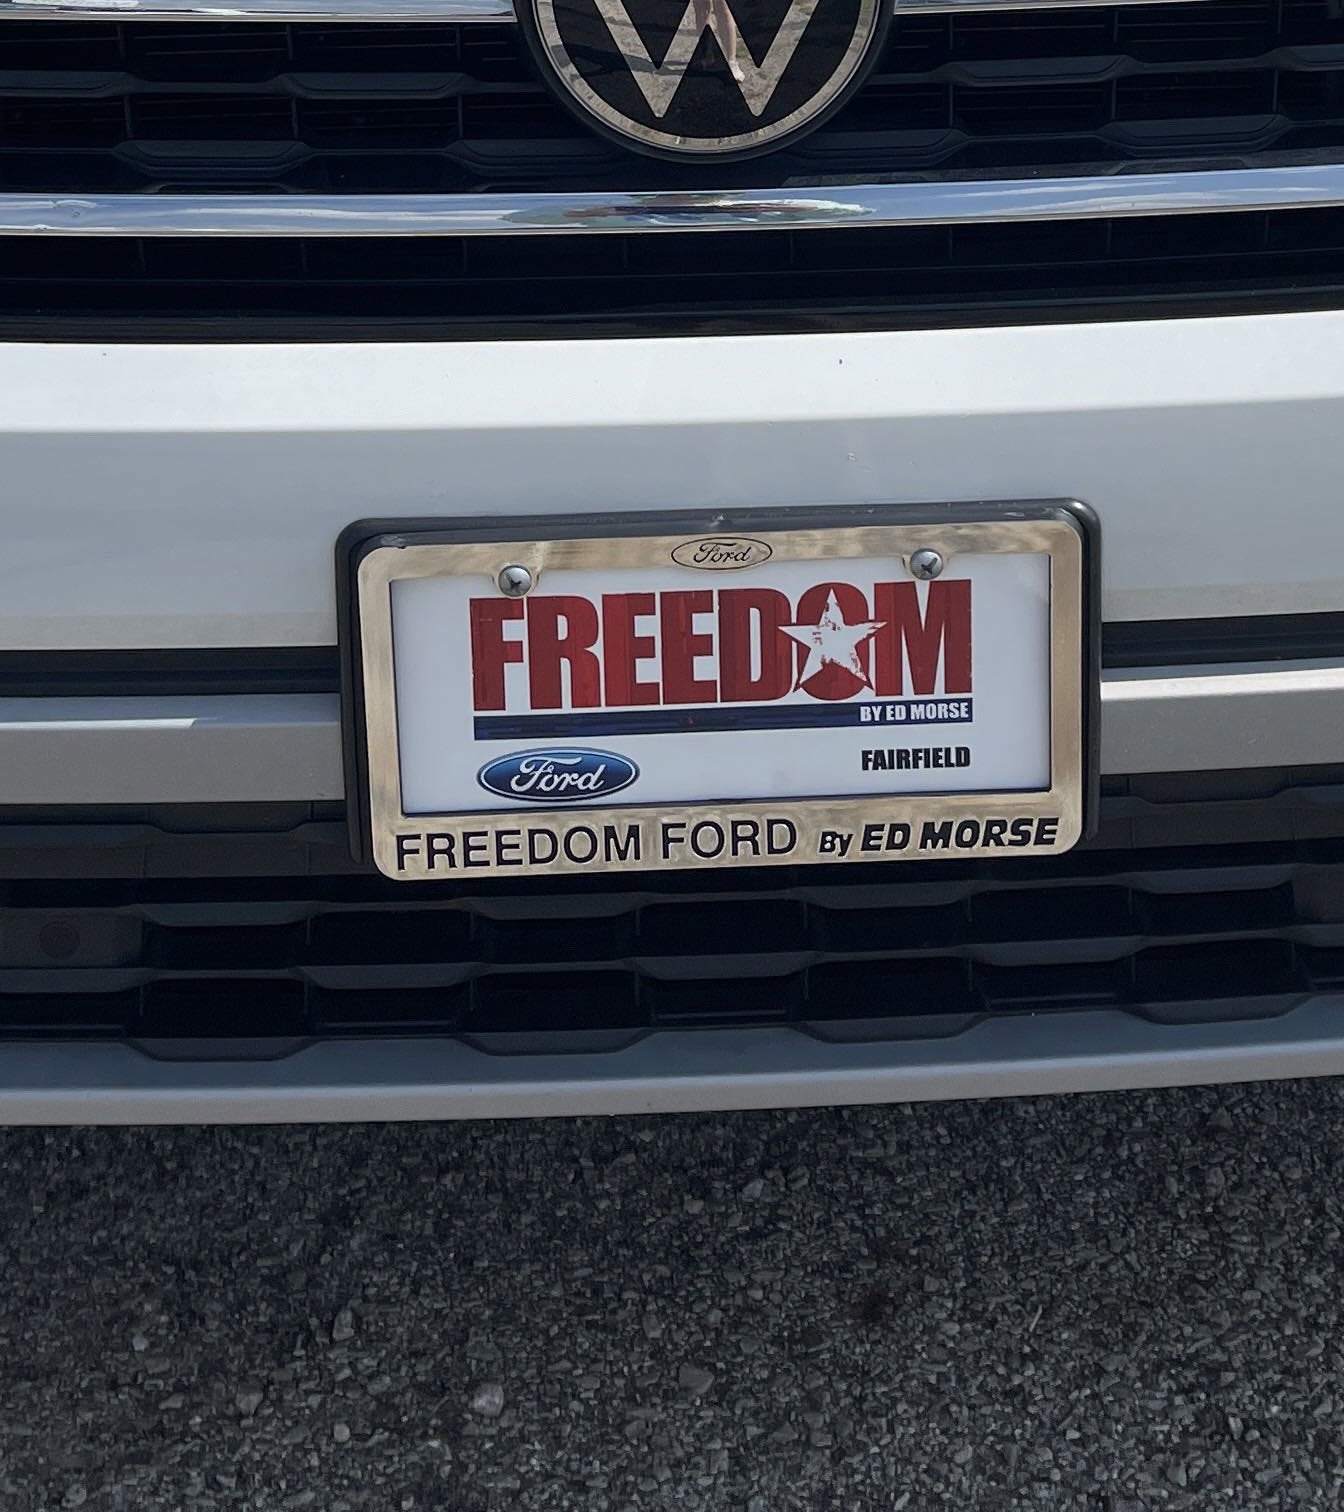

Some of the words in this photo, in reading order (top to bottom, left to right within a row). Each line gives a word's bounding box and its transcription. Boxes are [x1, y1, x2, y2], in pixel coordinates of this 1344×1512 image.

[693, 542, 752, 563] Ford
[470, 579, 972, 711] FREEDOM
[860, 705, 883, 722] BY
[885, 704, 906, 721] ED
[910, 701, 969, 720] MORSE
[861, 746, 971, 771] FAIRFIELD
[510, 756, 606, 792] Ford
[395, 824, 642, 871] FREEDOM
[661, 818, 798, 860] FORD
[819, 831, 854, 857] By
[860, 823, 911, 852] ED
[918, 817, 1060, 850] MORSE
